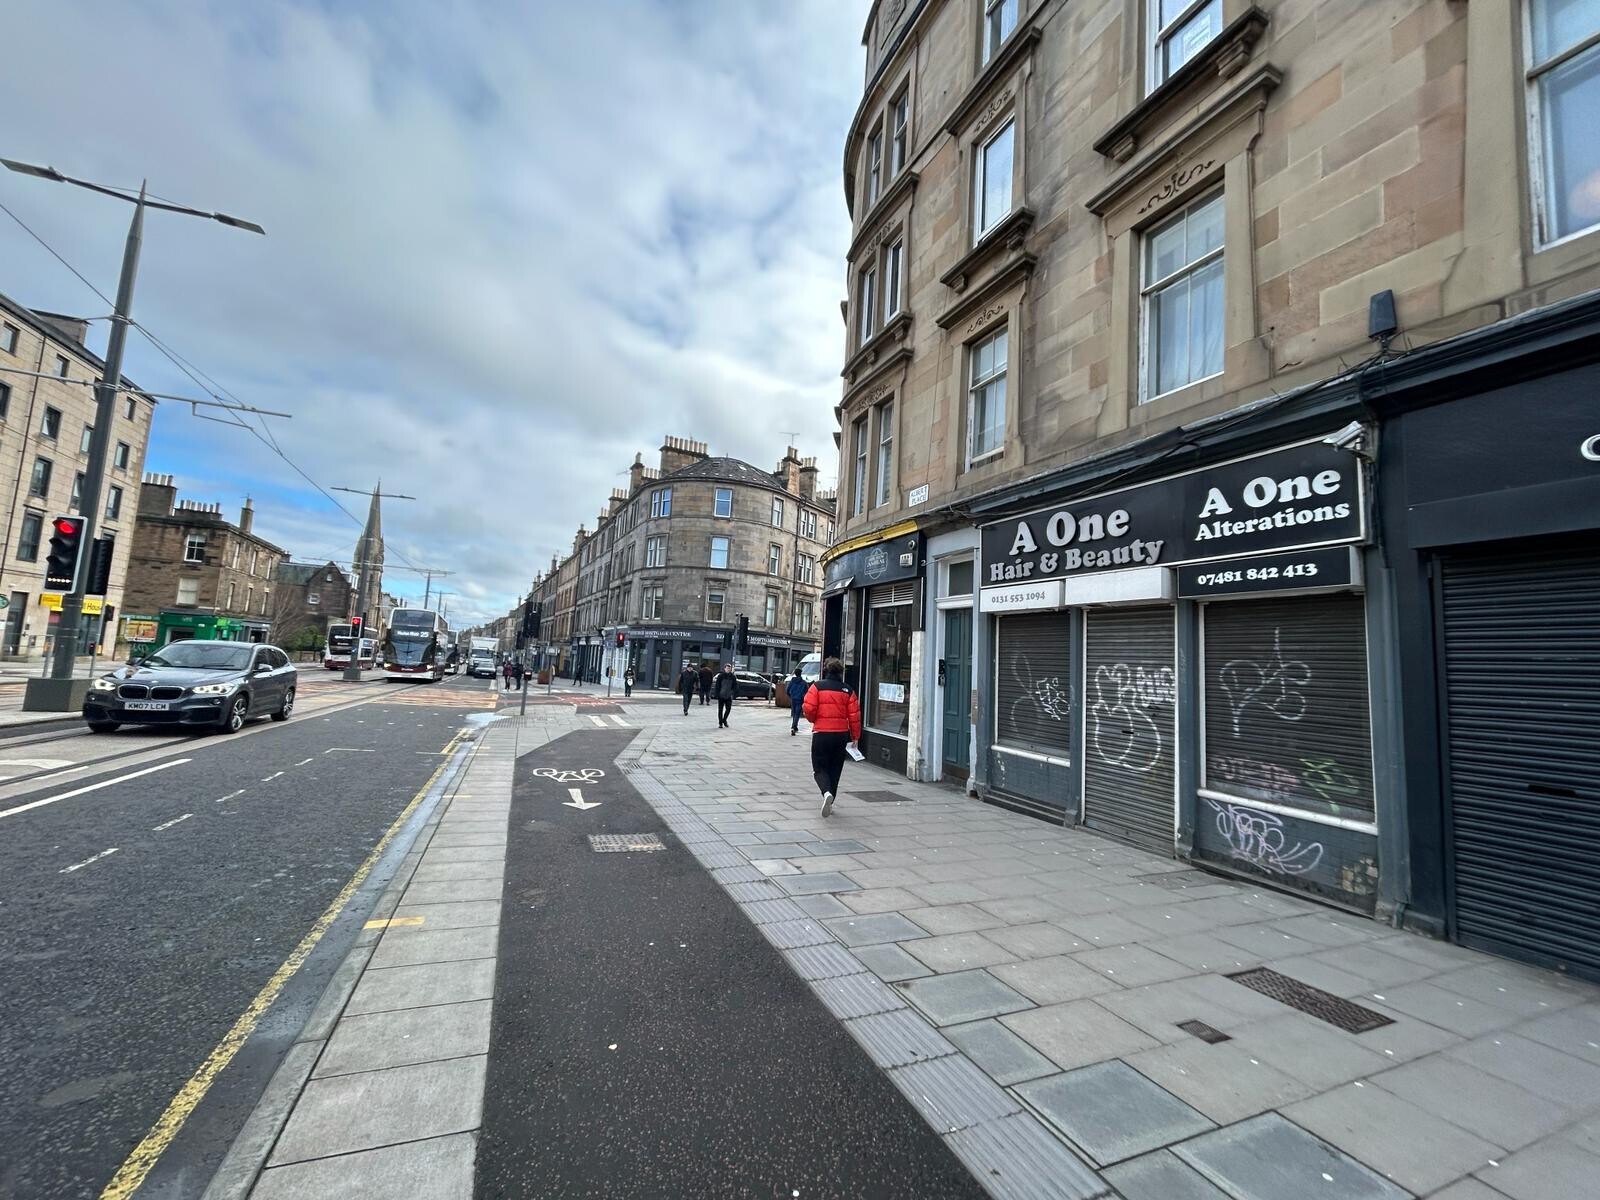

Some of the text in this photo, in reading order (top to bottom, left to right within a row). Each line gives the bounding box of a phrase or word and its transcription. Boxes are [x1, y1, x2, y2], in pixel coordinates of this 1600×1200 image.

[911, 494, 927, 505] PLACE
[1198, 469, 1341, 518] A One
[1009, 509, 1130, 556] A One
[1195, 502, 1350, 541] Alterations
[990, 538, 1166, 582] Hair & Beauty
[1197, 563, 1319, 586] 07481 842 413
[991, 590, 1046, 604] 0131 553 1094
